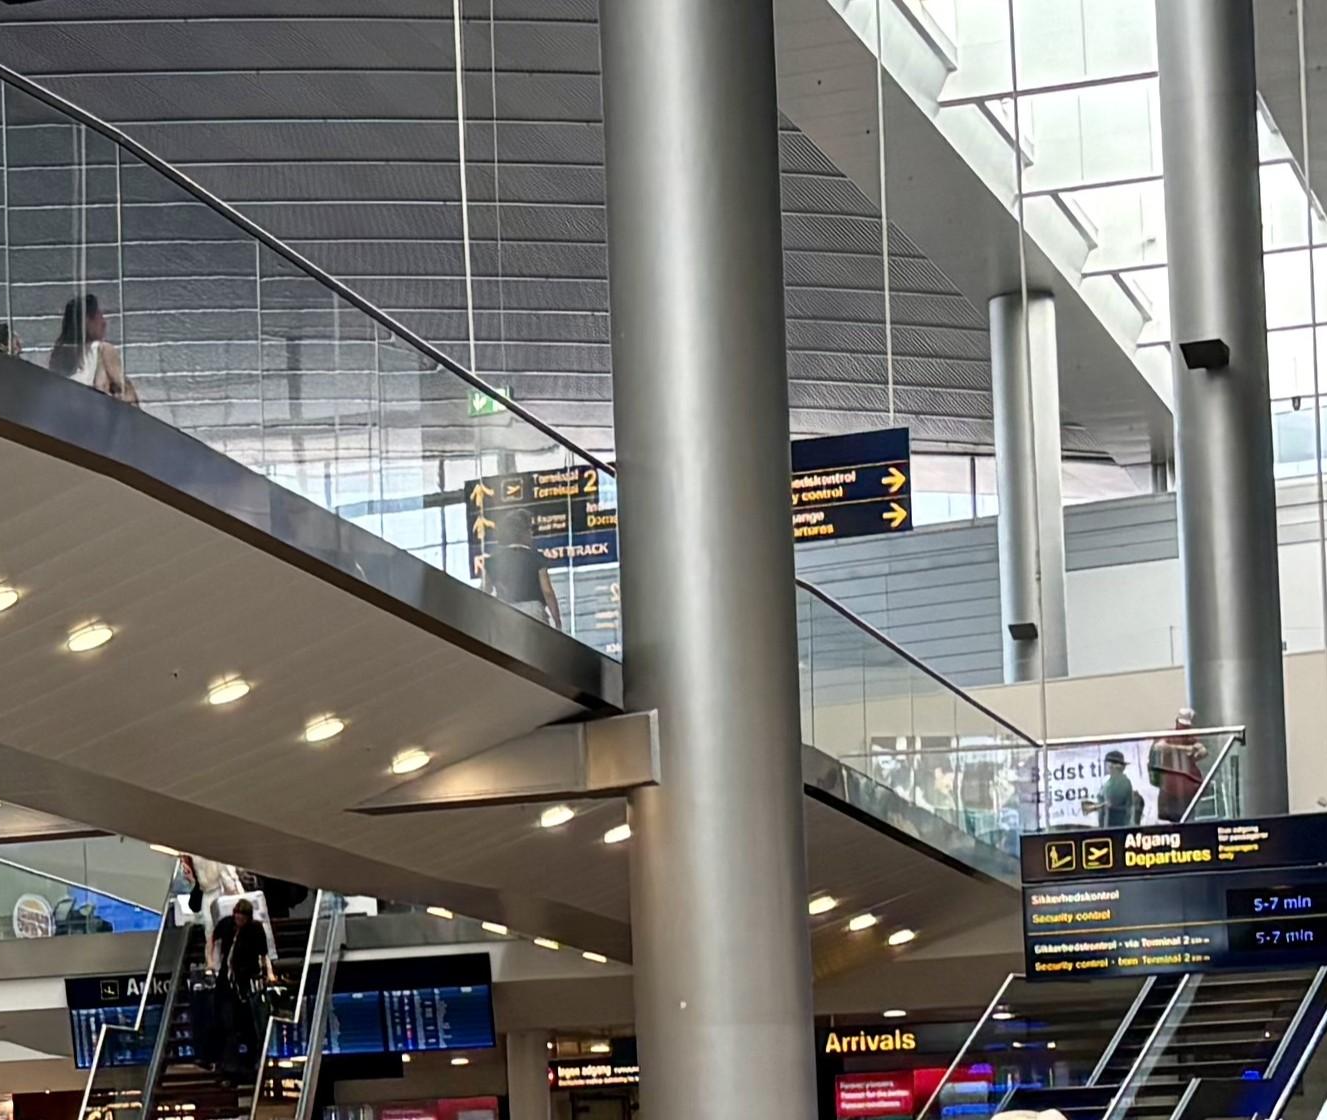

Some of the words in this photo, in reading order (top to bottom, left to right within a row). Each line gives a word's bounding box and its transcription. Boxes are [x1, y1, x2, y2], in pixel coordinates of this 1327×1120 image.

[532, 469, 579, 485] Terminal
[583, 470, 598, 492] 2
[791, 470, 856, 489] edskontrol
[533, 484, 579, 499] Terminal
[802, 486, 843, 501] control
[1125, 832, 1181, 850] Afgang
[1125, 849, 1211, 868] Departures
[1031, 890, 1120, 905] Sikkerhedskontrol
[1254, 897, 1279, 912] 5-7
[1284, 895, 1312, 909] min
[1032, 913, 1073, 925] Security
[1076, 910, 1111, 921] control
[1141, 936, 1181, 948] Terminal
[1255, 931, 1281, 944] 5-7
[1285, 929, 1314, 943] min
[1035, 961, 1073, 972] Security
[1076, 958, 1109, 969] control
[1142, 954, 1182, 965] Terminal
[825, 1029, 916, 1053] Arrivals
